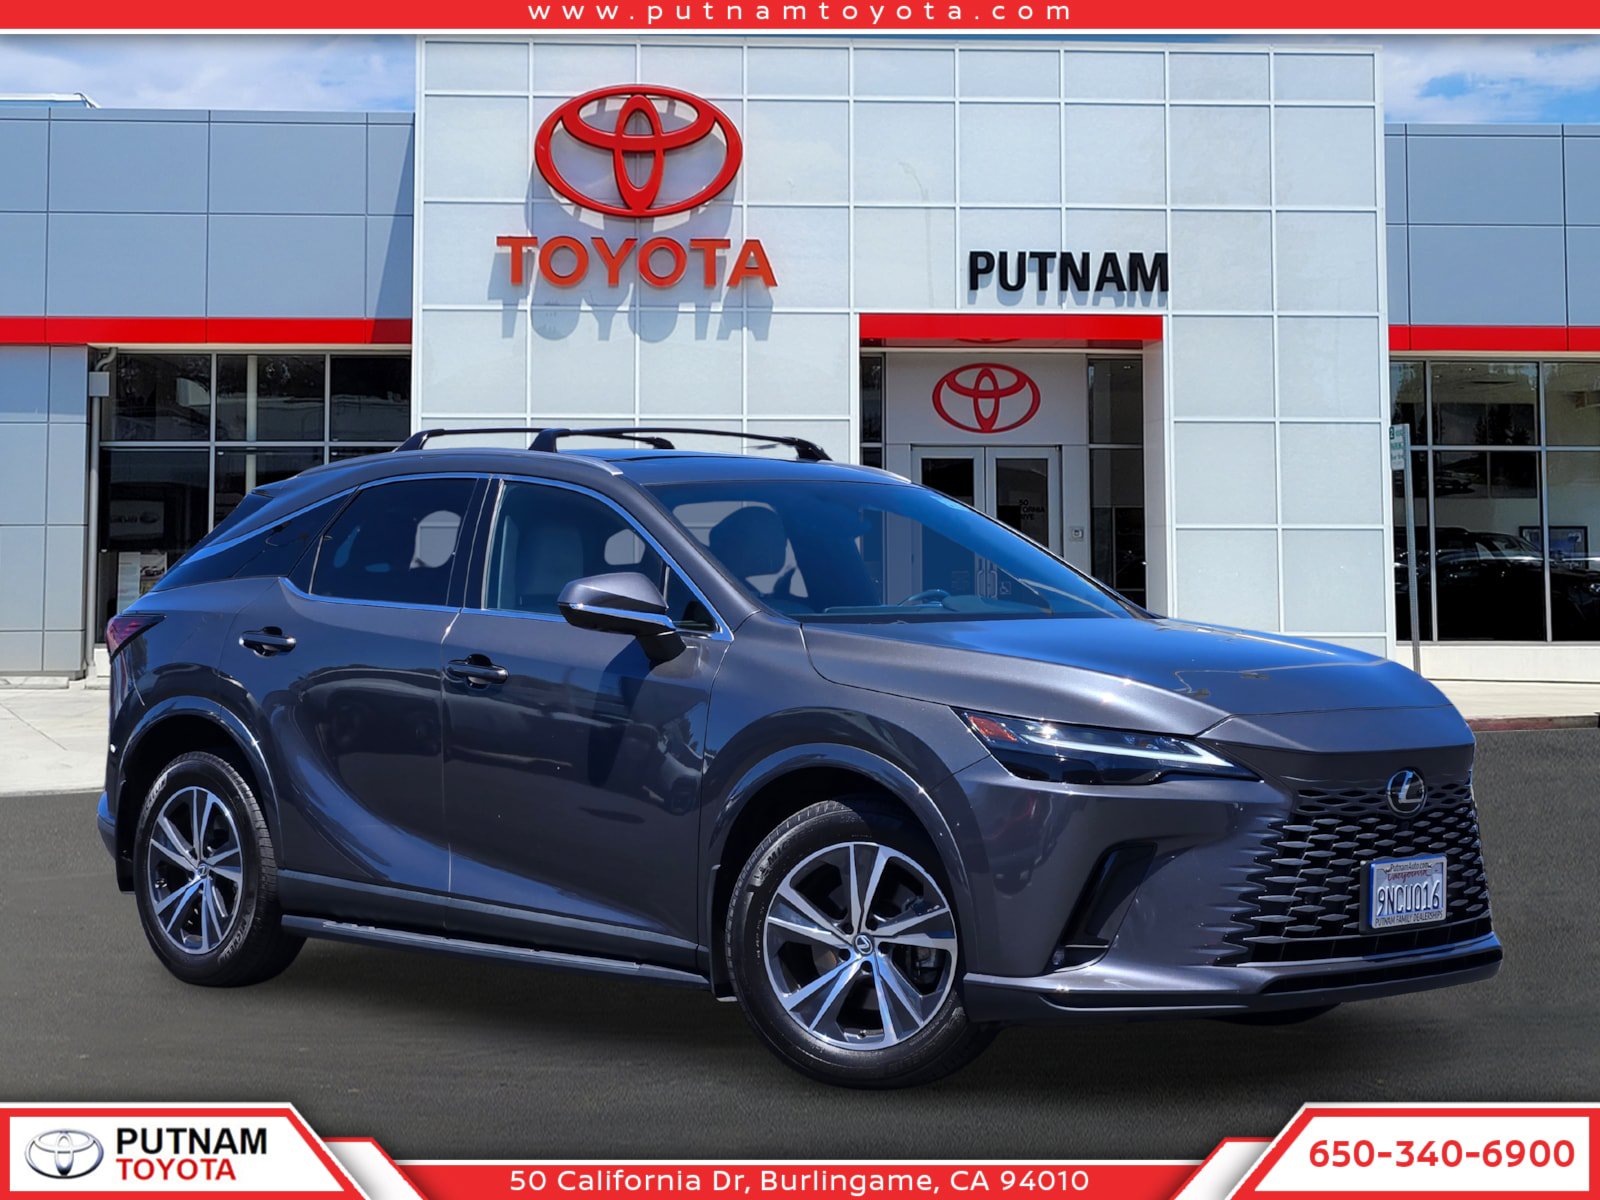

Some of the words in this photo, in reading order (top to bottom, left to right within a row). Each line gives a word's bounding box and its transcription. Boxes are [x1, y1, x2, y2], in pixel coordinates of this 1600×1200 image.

[496, 236, 778, 288] TOYOTA
[969, 251, 1169, 293] PUTNAM
[1376, 880, 1441, 916] 9NCU016
[1375, 916, 1396, 927] PUTNAM
[1396, 914, 1412, 924] FAMILY
[1413, 911, 1443, 922] DEALERSHIPS
